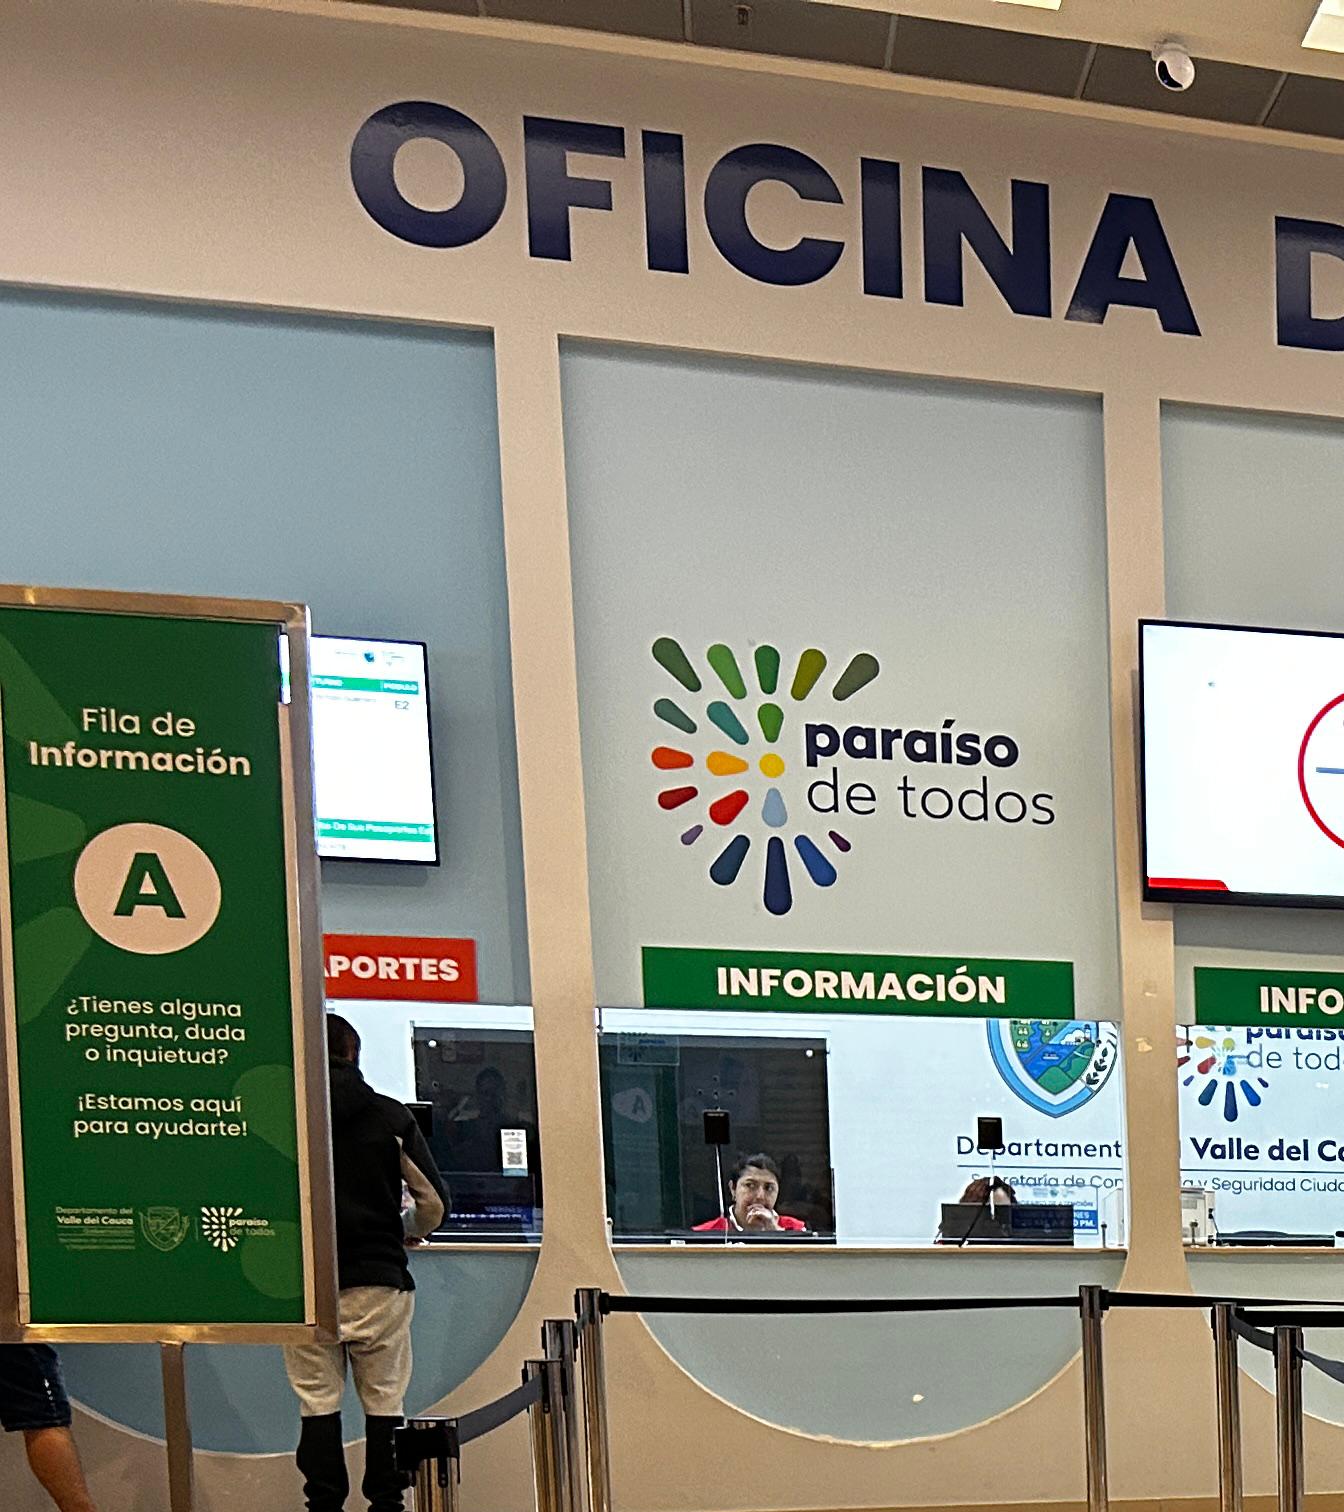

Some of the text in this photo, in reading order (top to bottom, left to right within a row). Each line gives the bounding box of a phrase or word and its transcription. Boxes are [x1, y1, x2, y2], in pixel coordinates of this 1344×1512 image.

[350, 100, 1201, 337] OFICINA
[82, 707, 196, 738] Fila de
[804, 719, 1020, 768] paraíso
[29, 741, 251, 776] Información
[807, 768, 1055, 825] de todos
[113, 852, 187, 919] A
[717, 965, 1006, 1004] INFORMACIÓN
[66, 995, 242, 1021] ¿Tienes alguna
[65, 1022, 246, 1043] pregunta, duda
[85, 1044, 229, 1068] o inquietud?
[1247, 1043, 1283, 1069] de
[78, 1093, 242, 1118] ¡Estamos aquí
[73, 1118, 248, 1140] para ayudarte!
[1190, 1137, 1260, 1160] Valle
[1268, 1138, 1309, 1161] del
[971, 1173, 1063, 1187] Sretaría
[1063, 1173, 1086, 1188] de
[1211, 1177, 1296, 1195] Seguridad
[56, 1216, 134, 1226] Valle del Cauca
